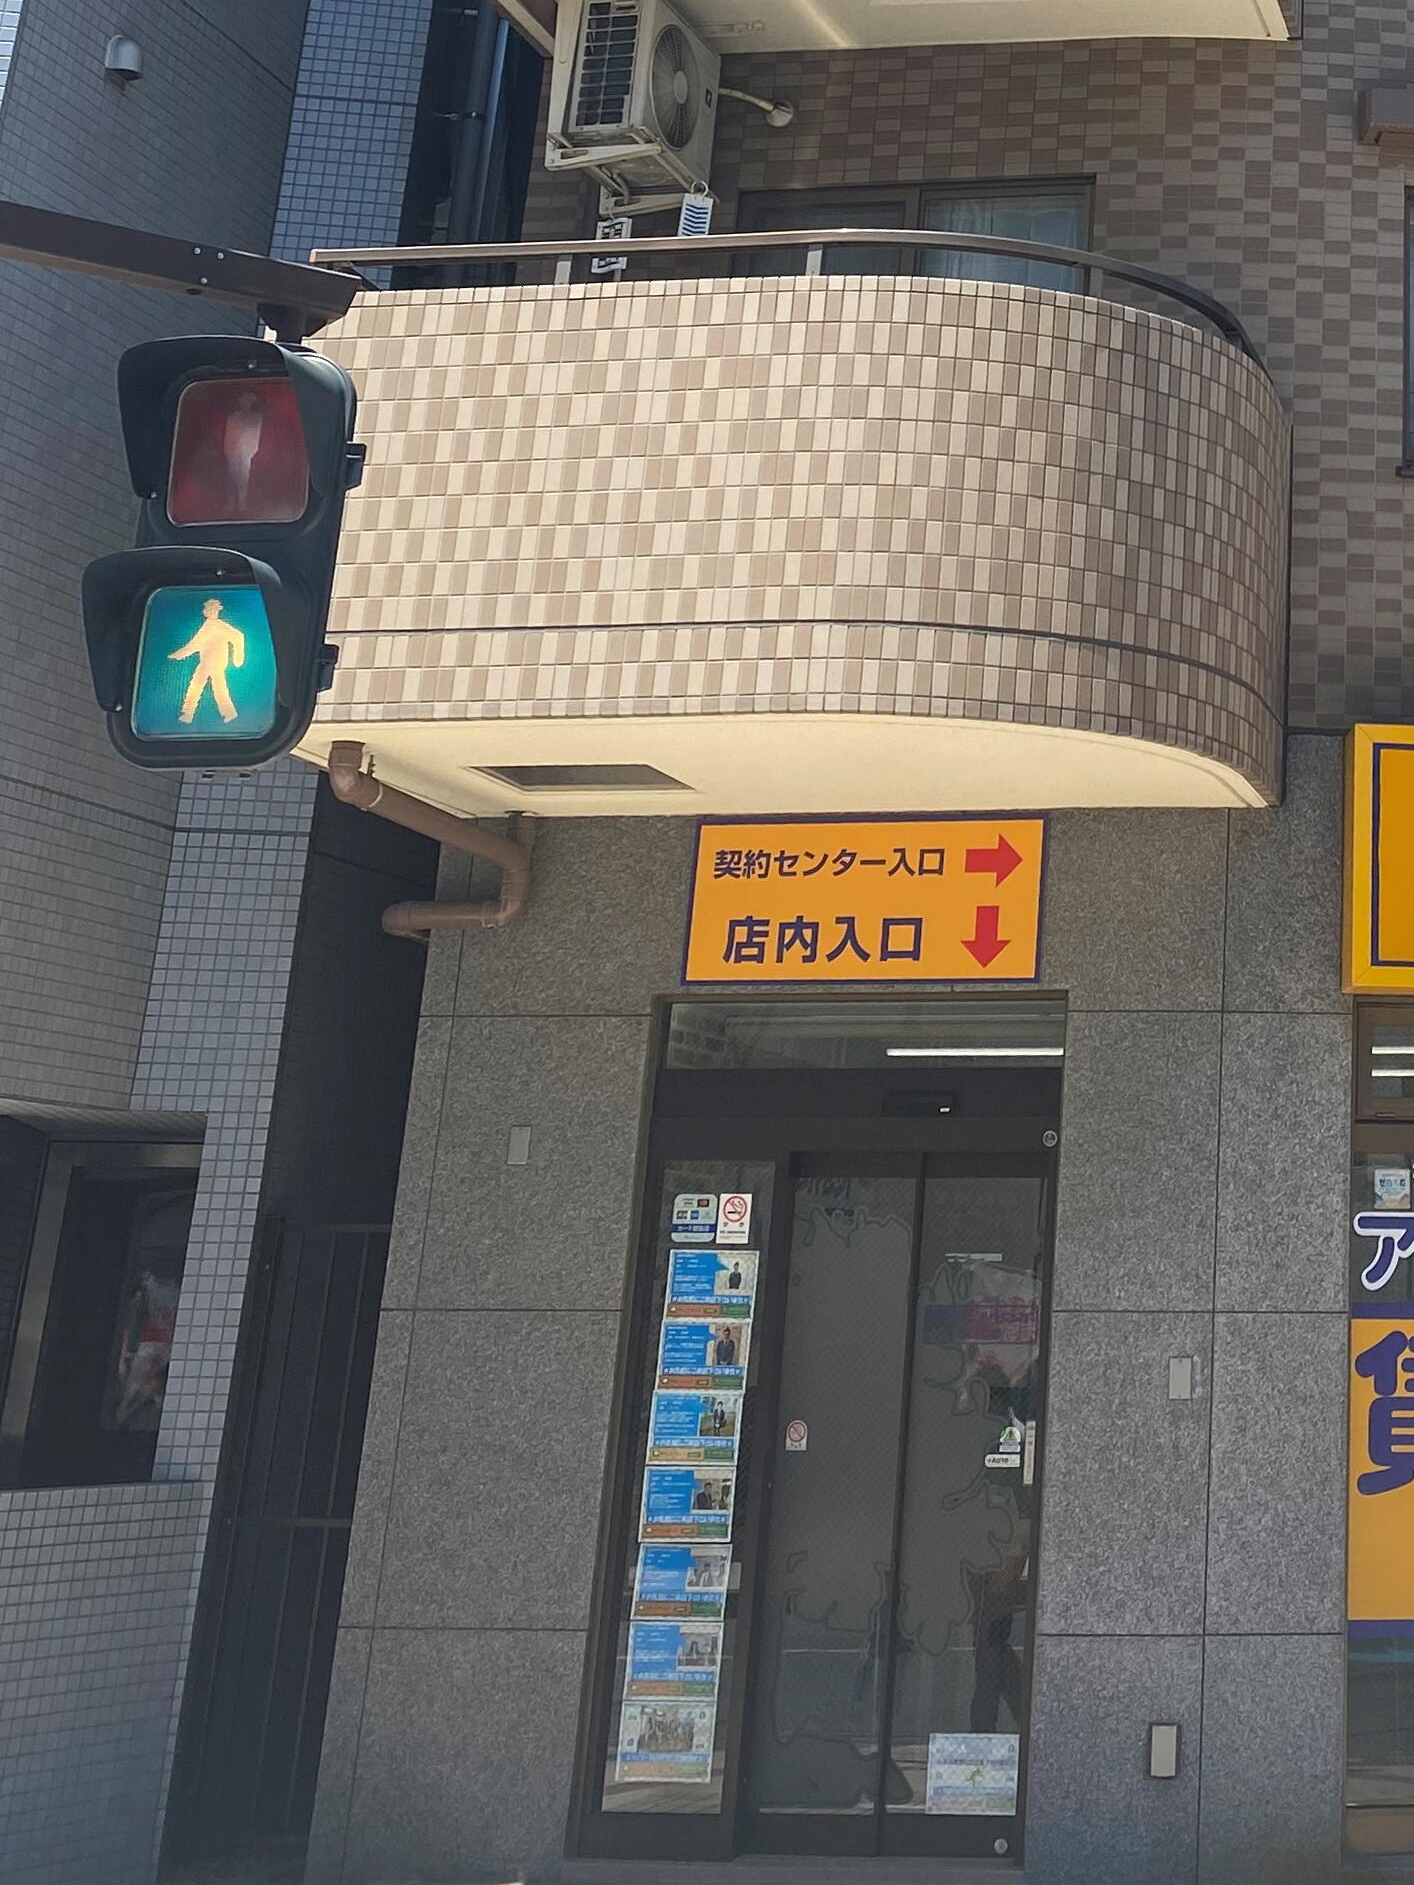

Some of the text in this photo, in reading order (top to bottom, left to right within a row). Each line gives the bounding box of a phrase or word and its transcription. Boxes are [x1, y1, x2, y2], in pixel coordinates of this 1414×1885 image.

[713, 847, 945, 880] 契約センター入口
[722, 915, 923, 964] 店内入口
